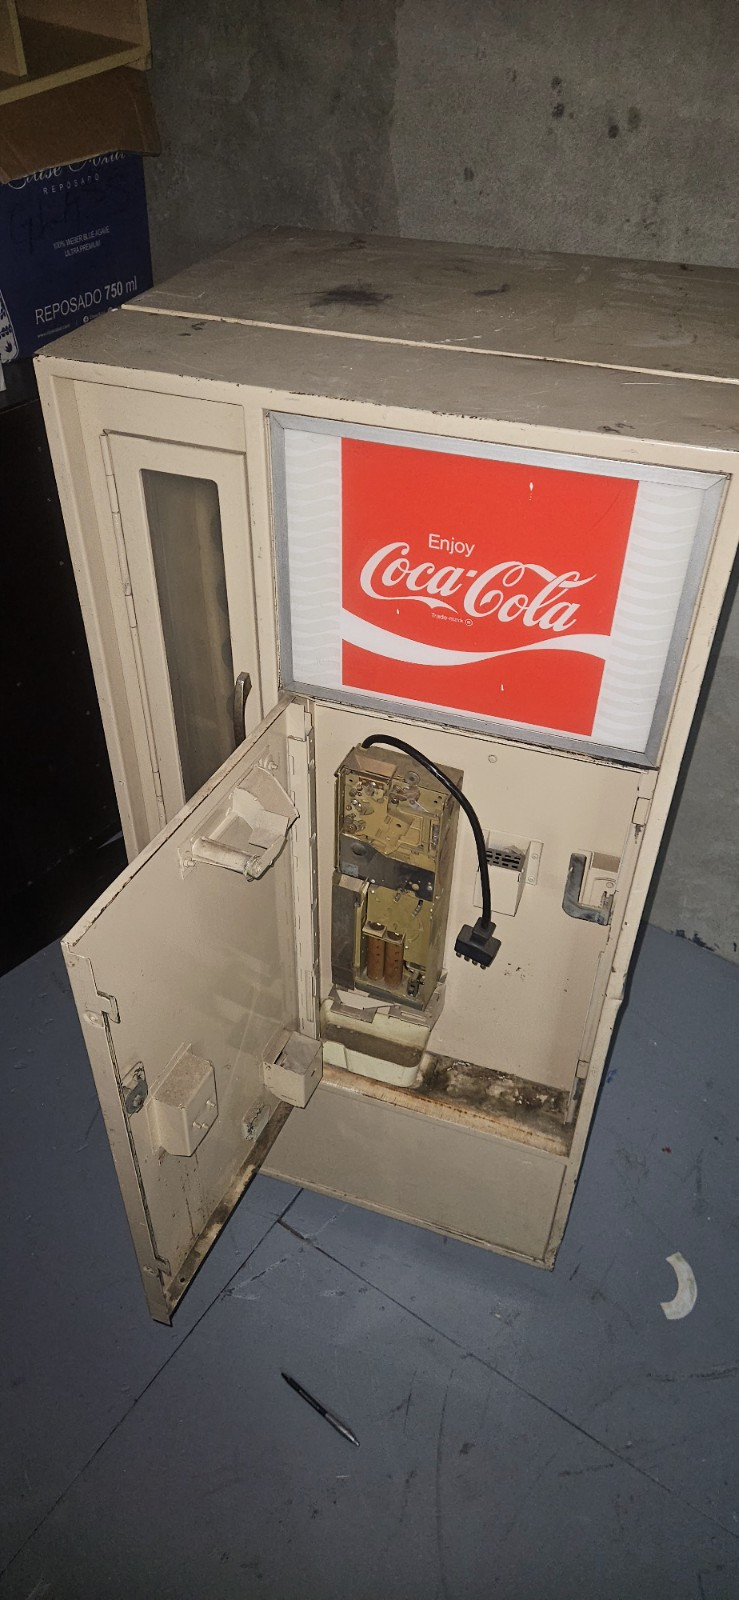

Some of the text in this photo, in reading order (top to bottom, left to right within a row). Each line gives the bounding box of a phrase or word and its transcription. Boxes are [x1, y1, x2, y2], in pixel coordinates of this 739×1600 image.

[35, 275, 138, 325] REPOSADO 750 ml
[428, 533, 475, 558] Enjoy
[360, 541, 597, 632] Coca-Cola
